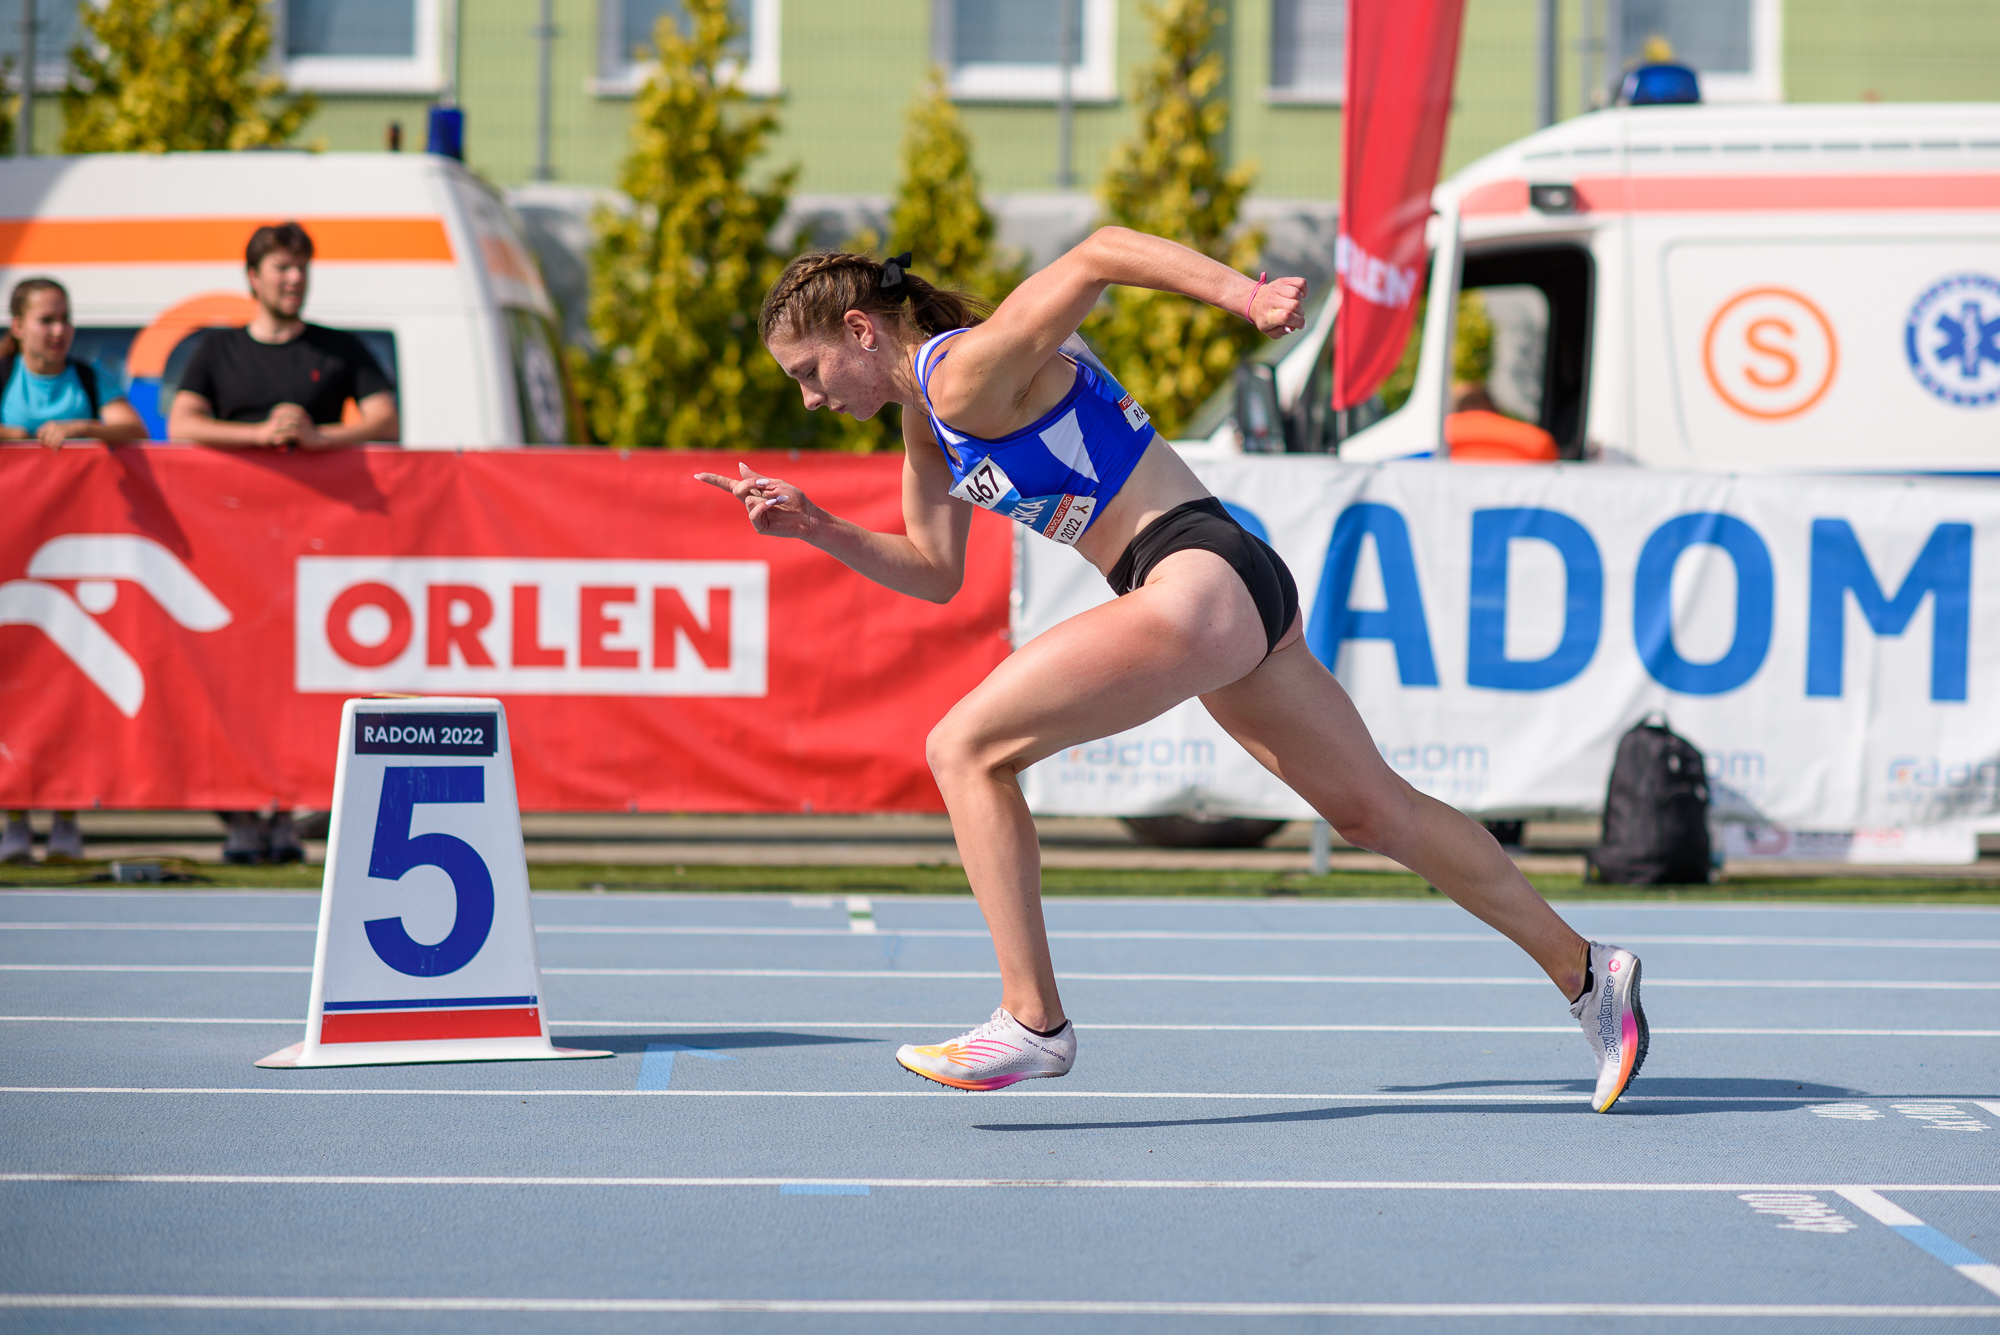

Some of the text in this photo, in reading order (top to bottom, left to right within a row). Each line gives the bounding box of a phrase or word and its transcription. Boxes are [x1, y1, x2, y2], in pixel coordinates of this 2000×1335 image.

[1742, 317, 1800, 389] S
[965, 464, 1000, 504] 467
[1060, 517, 1083, 541] 2022
[324, 580, 732, 672] ORLEN
[1219, 501, 1974, 703] ADOM
[364, 726, 484, 745] RADOM 2022
[363, 765, 495, 978] 5
[1023, 1037, 1066, 1062] new balance
[1598, 975, 1620, 1063] new balance
